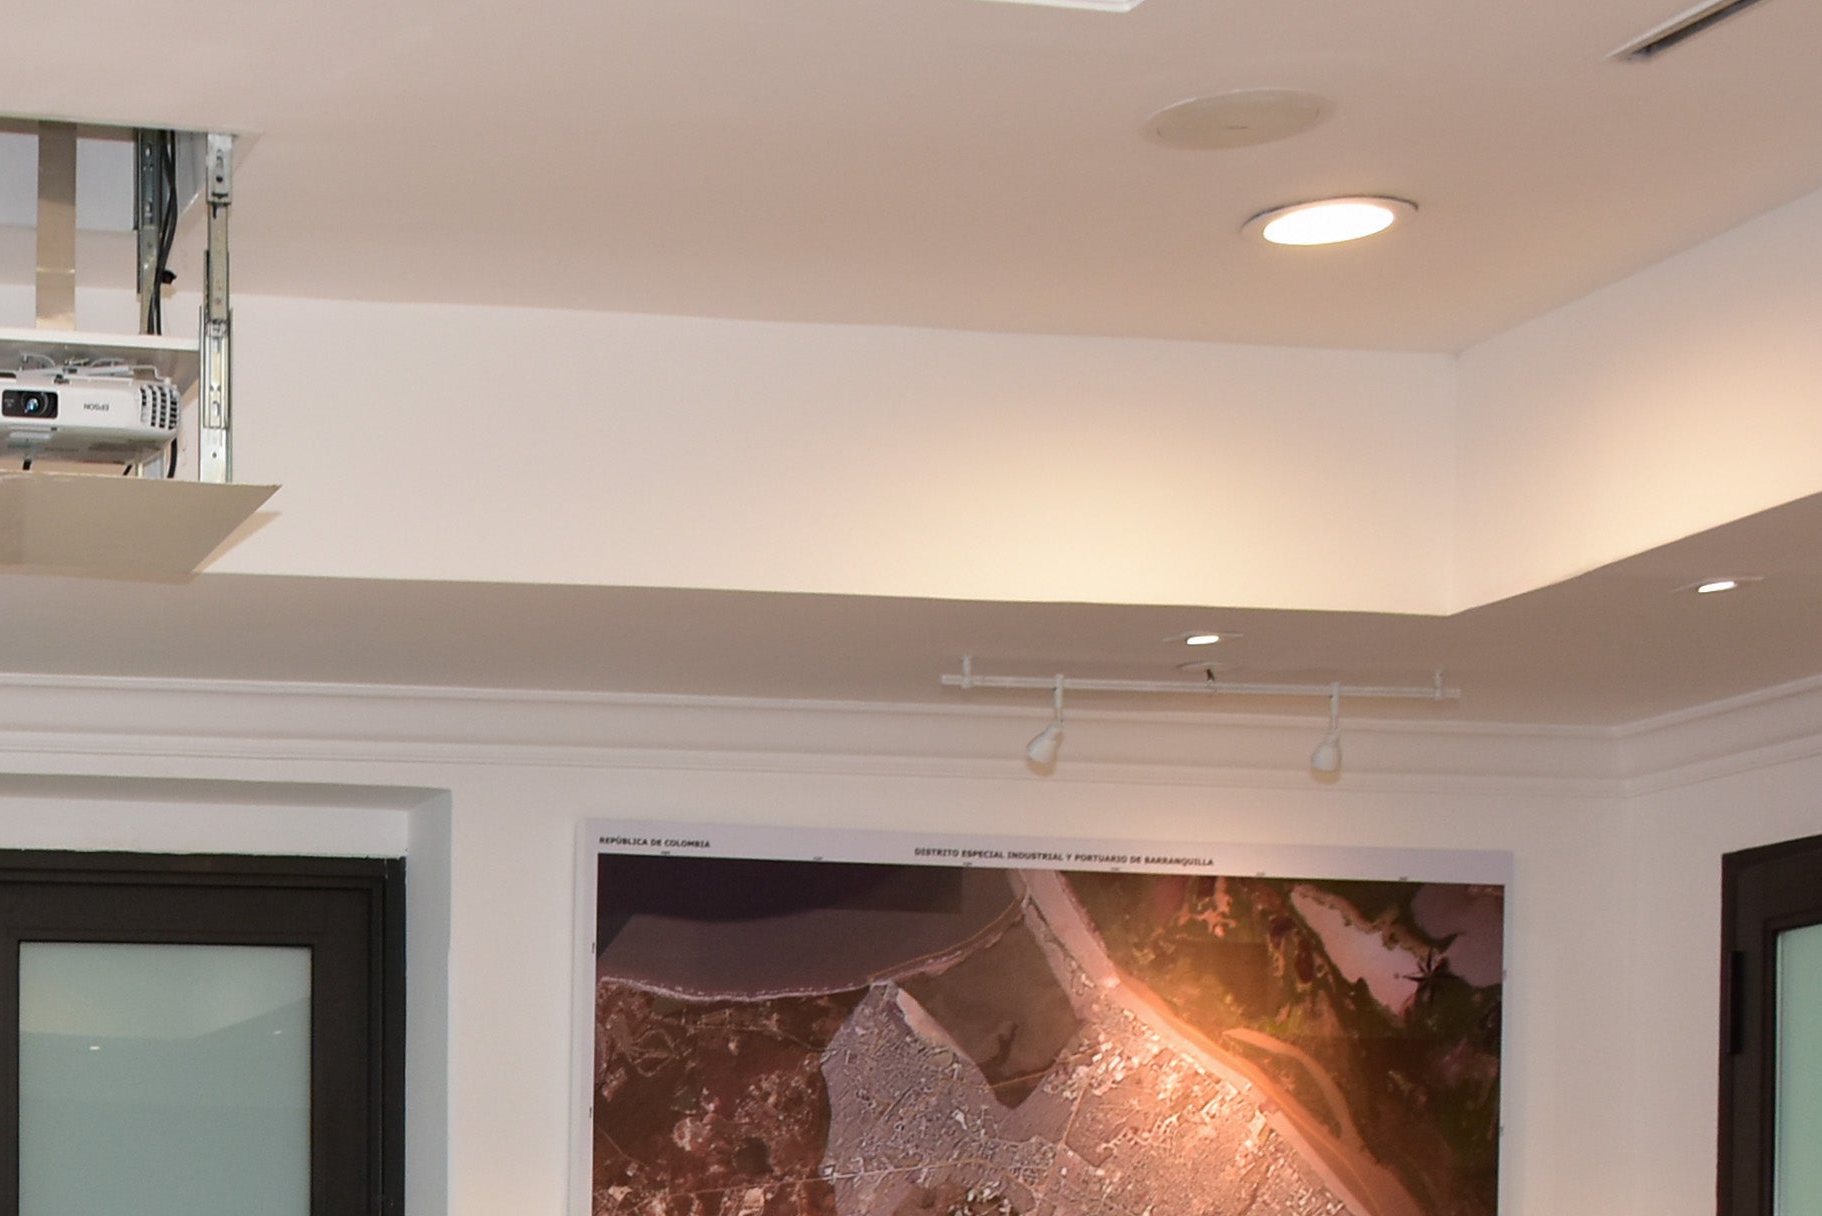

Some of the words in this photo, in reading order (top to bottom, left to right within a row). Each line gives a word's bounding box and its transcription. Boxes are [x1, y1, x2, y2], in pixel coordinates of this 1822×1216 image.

[83, 402, 109, 411] EPSON
[599, 836, 648, 846] REPÚBLICA
[650, 838, 662, 847] DE
[664, 839, 710, 848] COLOMBIA
[914, 847, 959, 857] DISTRITO
[961, 849, 1004, 859] ESPECIAL
[1007, 851, 1064, 861] INDUSTRIAL
[1074, 853, 1127, 864] PORTUARIO
[1128, 856, 1141, 864] DE
[1144, 856, 1214, 867] BARRANQUILLA
